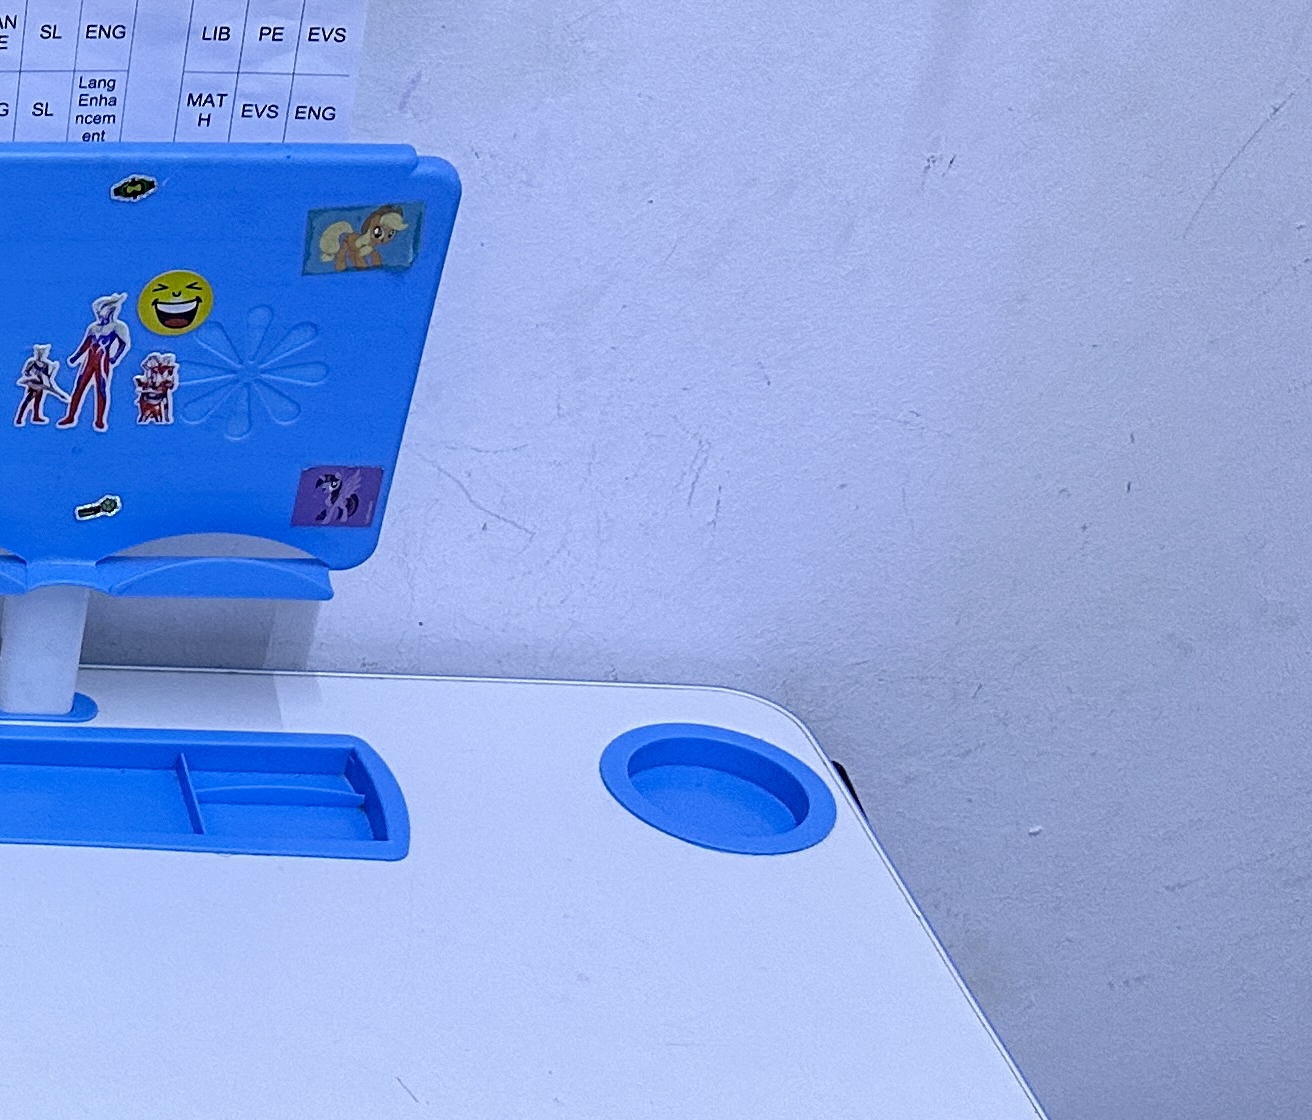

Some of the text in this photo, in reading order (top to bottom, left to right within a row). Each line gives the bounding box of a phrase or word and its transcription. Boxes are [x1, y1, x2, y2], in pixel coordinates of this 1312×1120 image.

[40, 25, 62, 39] SL
[85, 25, 126, 39] ENG
[202, 26, 231, 41] LIB
[258, 27, 284, 42] PE
[307, 27, 346, 42] EVS
[79, 76, 116, 92] Lang
[78, 94, 117, 107] Enha
[187, 94, 227, 107] MAT
[32, 102, 54, 117] SL
[241, 104, 279, 119] EVS
[295, 106, 336, 121] ENG
[76, 113, 116, 125] ncem
[198, 113, 211, 127] H
[82, 130, 106, 142] ent
